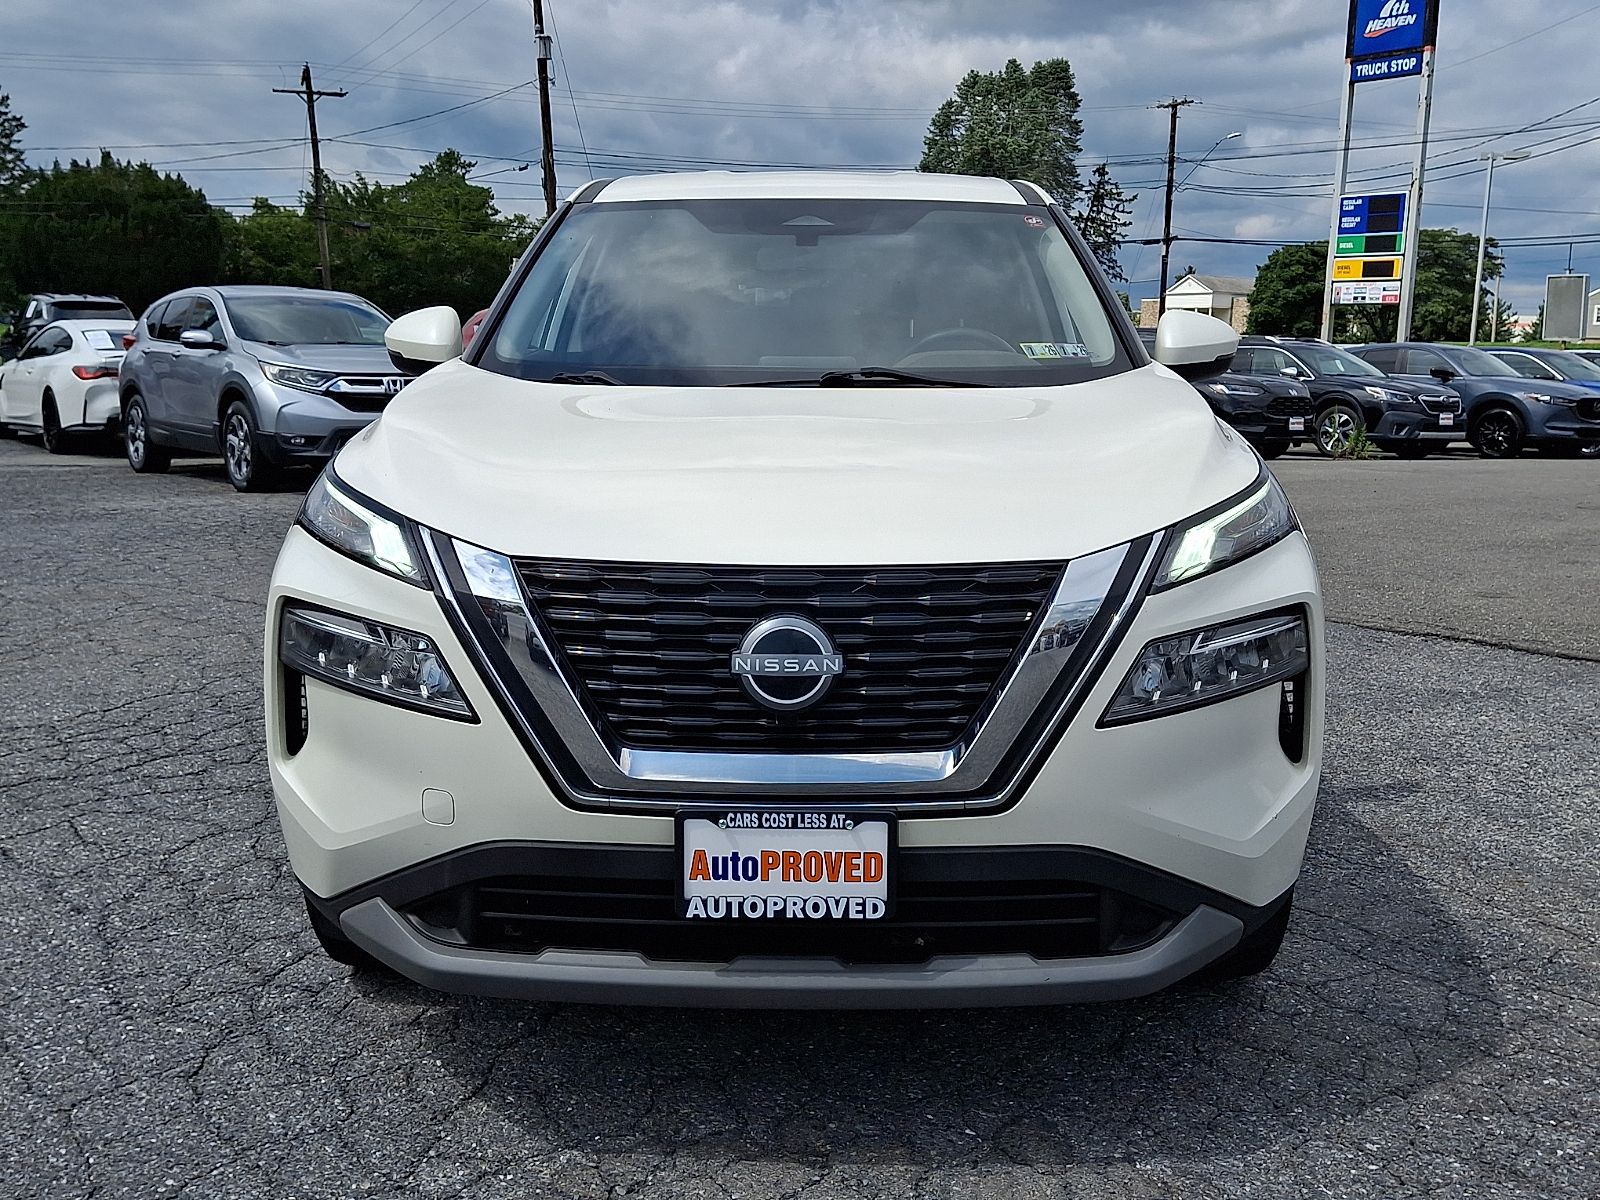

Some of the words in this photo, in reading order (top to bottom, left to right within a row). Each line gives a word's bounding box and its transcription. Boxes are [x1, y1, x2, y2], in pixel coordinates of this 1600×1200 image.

[1365, 14, 1417, 34] HEAVEN
[1356, 62, 1389, 77] TRUCK
[1390, 57, 1417, 73] STOP
[735, 657, 840, 673] NISSAN
[726, 812, 759, 828] CARS
[762, 813, 794, 828] COST
[798, 813, 828, 829] LESS
[830, 814, 846, 828] AT
[689, 849, 884, 883] AutoPROVED
[686, 896, 886, 919] AUTOPROVED
